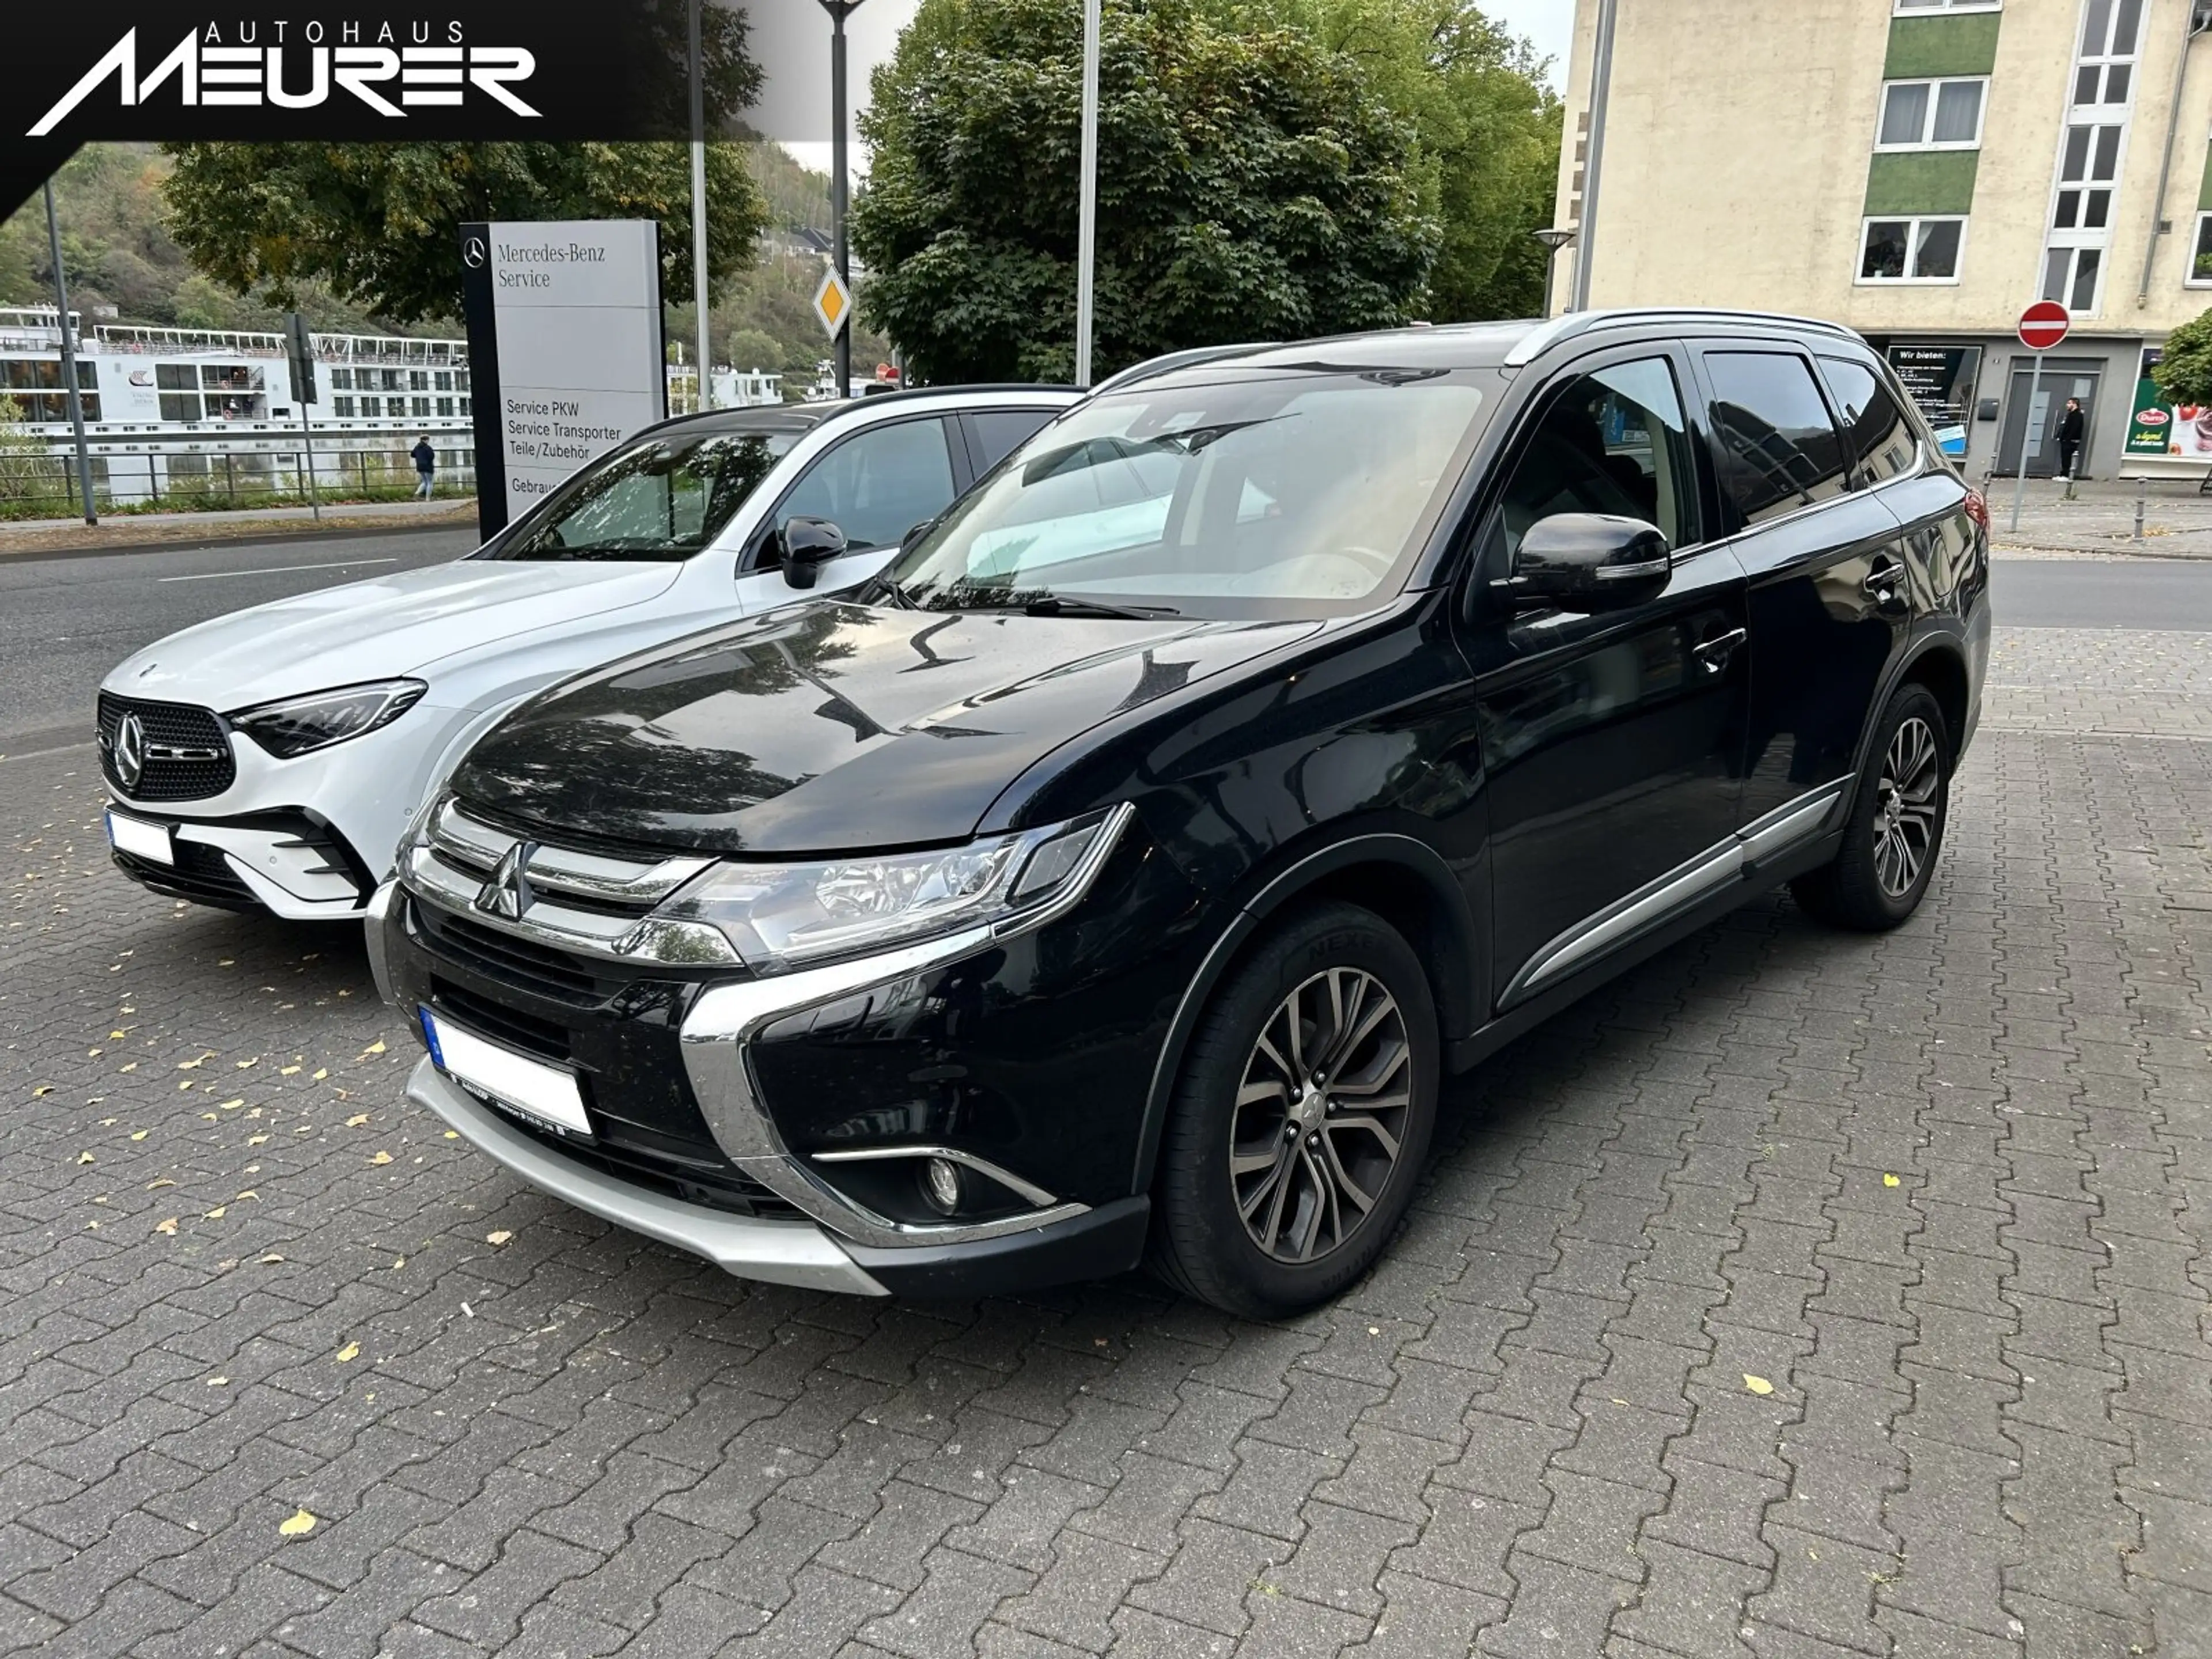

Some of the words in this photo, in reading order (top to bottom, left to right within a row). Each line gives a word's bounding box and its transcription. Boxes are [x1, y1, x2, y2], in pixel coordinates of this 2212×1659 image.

[498, 243, 605, 262] Mercedes-Benz
[498, 269, 550, 287] Service
[507, 399, 548, 415] Service
[552, 401, 579, 416] PKW
[509, 419, 550, 436] Service
[553, 422, 622, 442] Transporter
[510, 441, 590, 459] Teile/Zubehör
